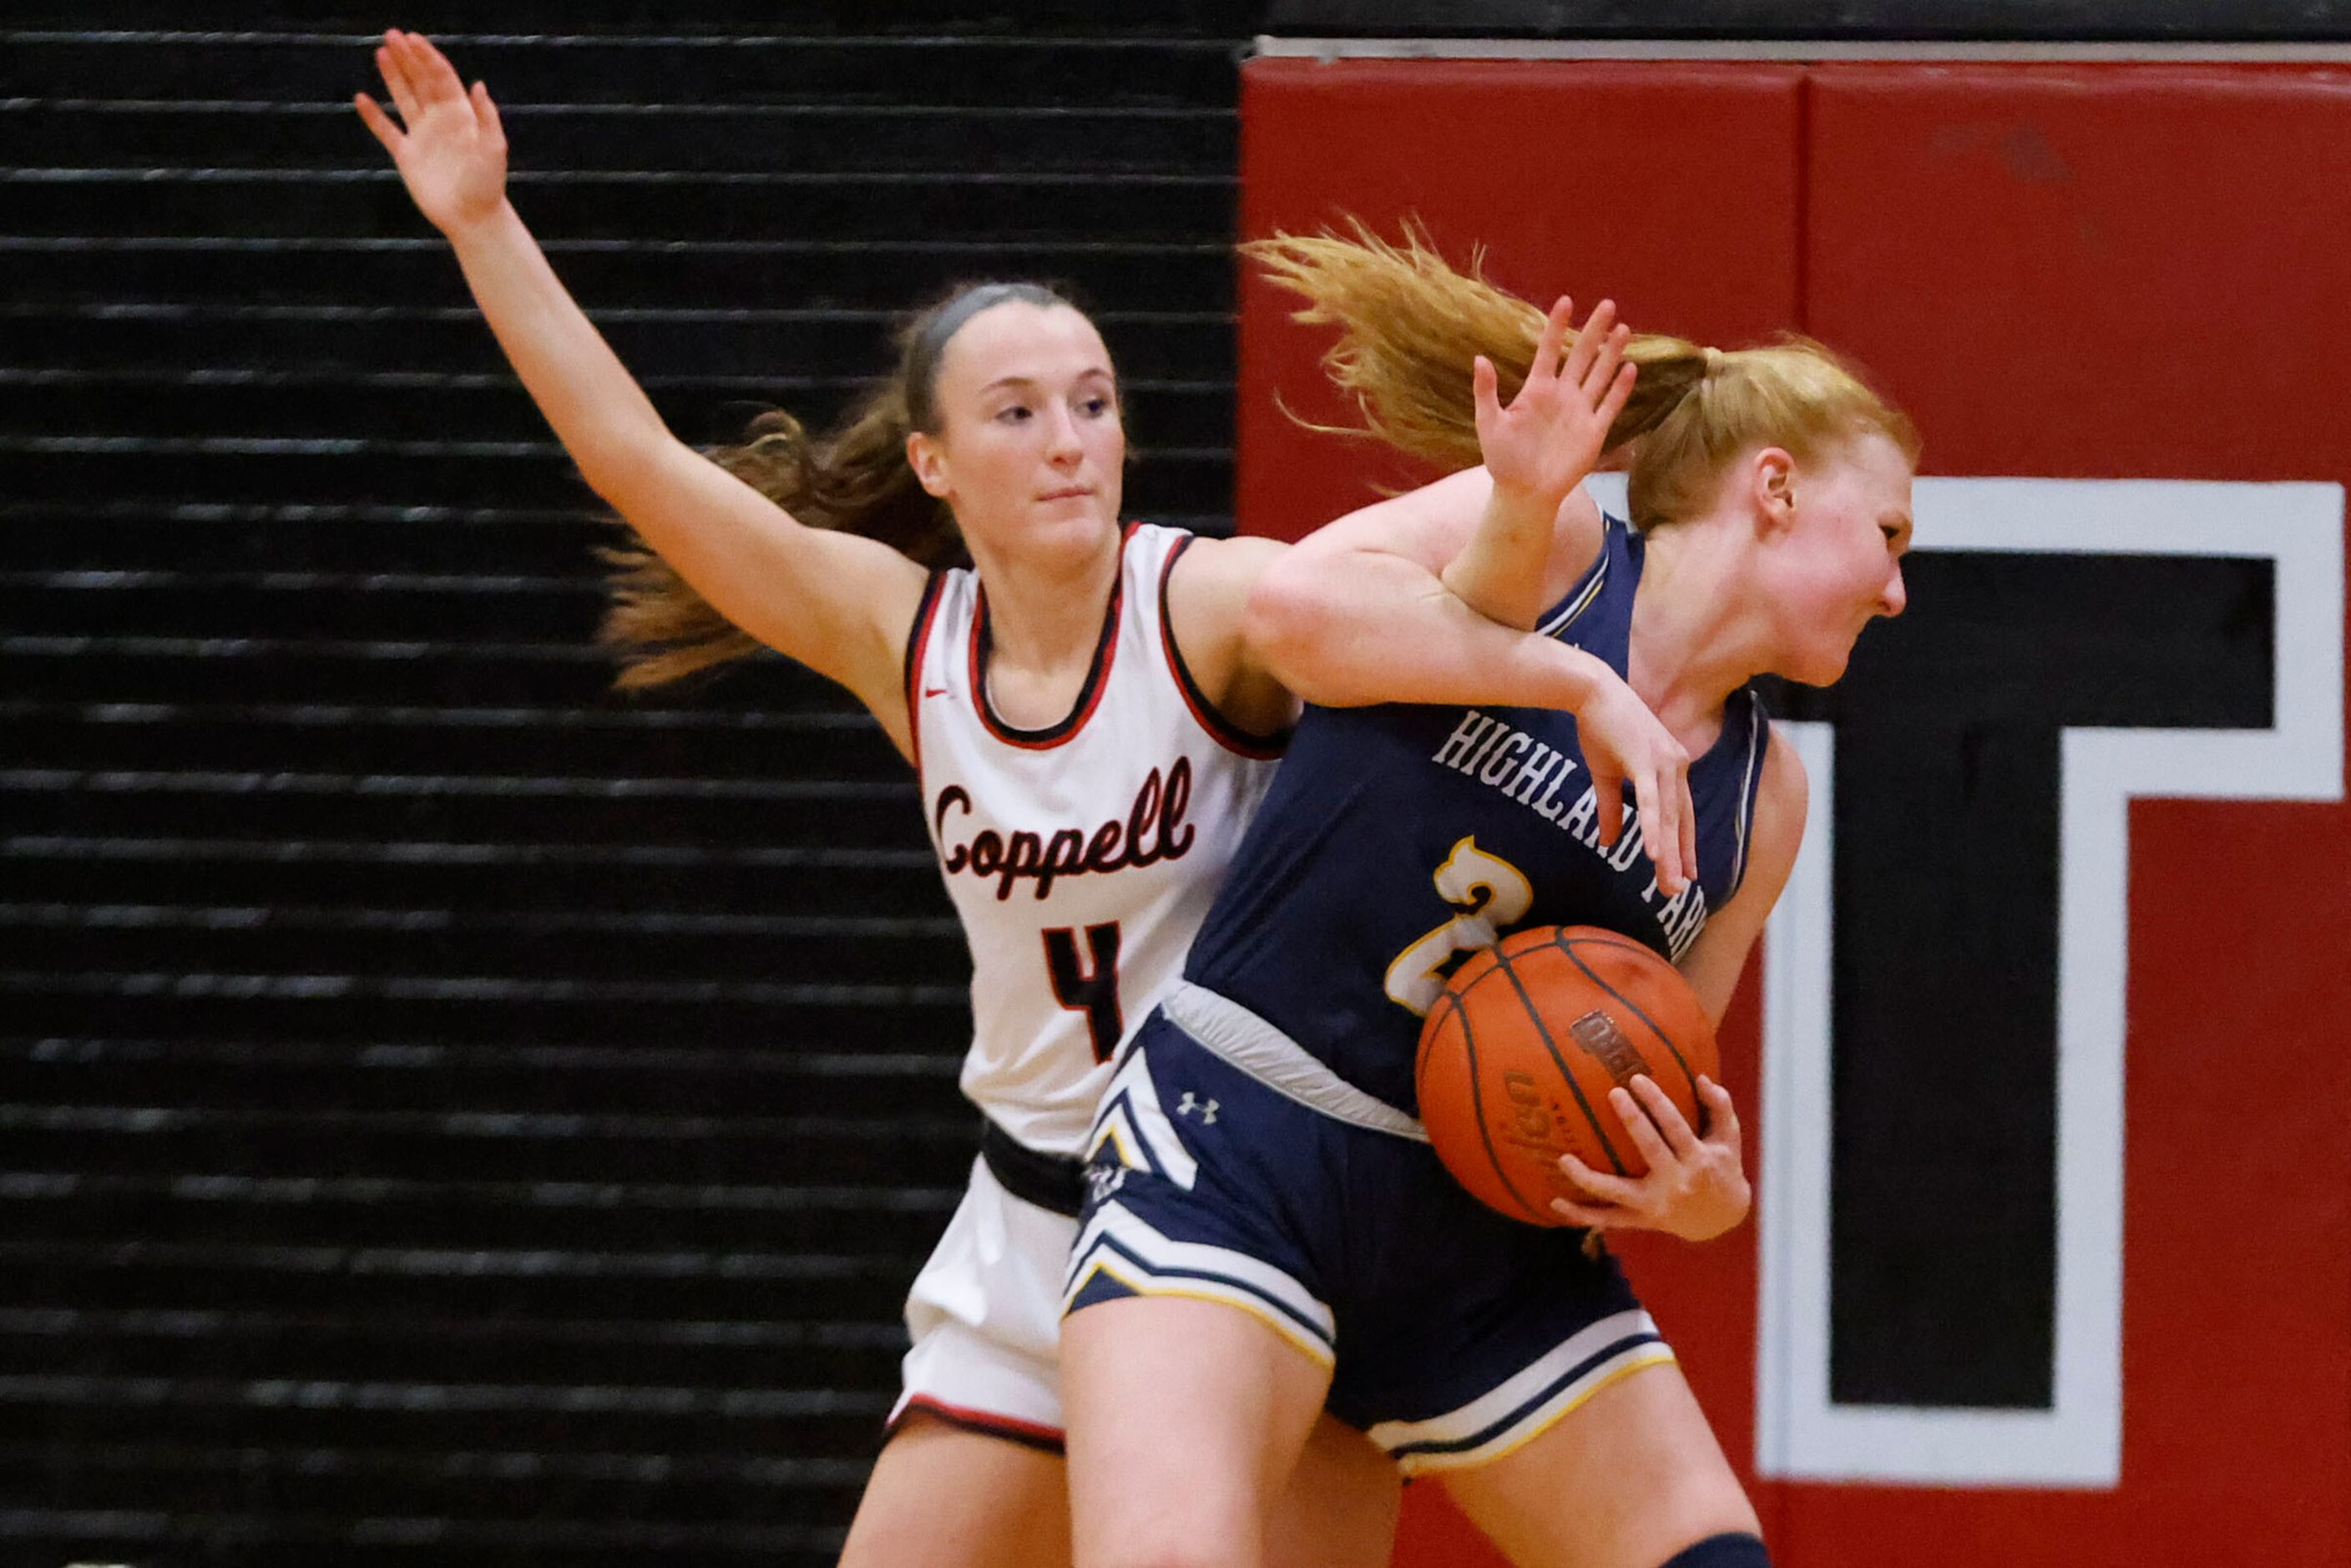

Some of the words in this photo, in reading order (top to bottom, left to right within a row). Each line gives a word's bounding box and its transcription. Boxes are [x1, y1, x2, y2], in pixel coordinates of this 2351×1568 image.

[936, 756, 1196, 901] Coppell
[1040, 921, 1124, 1065] 4
[1384, 834, 1534, 1018] 2
[1584, 471, 2344, 1491] T
[1641, 877, 1707, 966] AR
